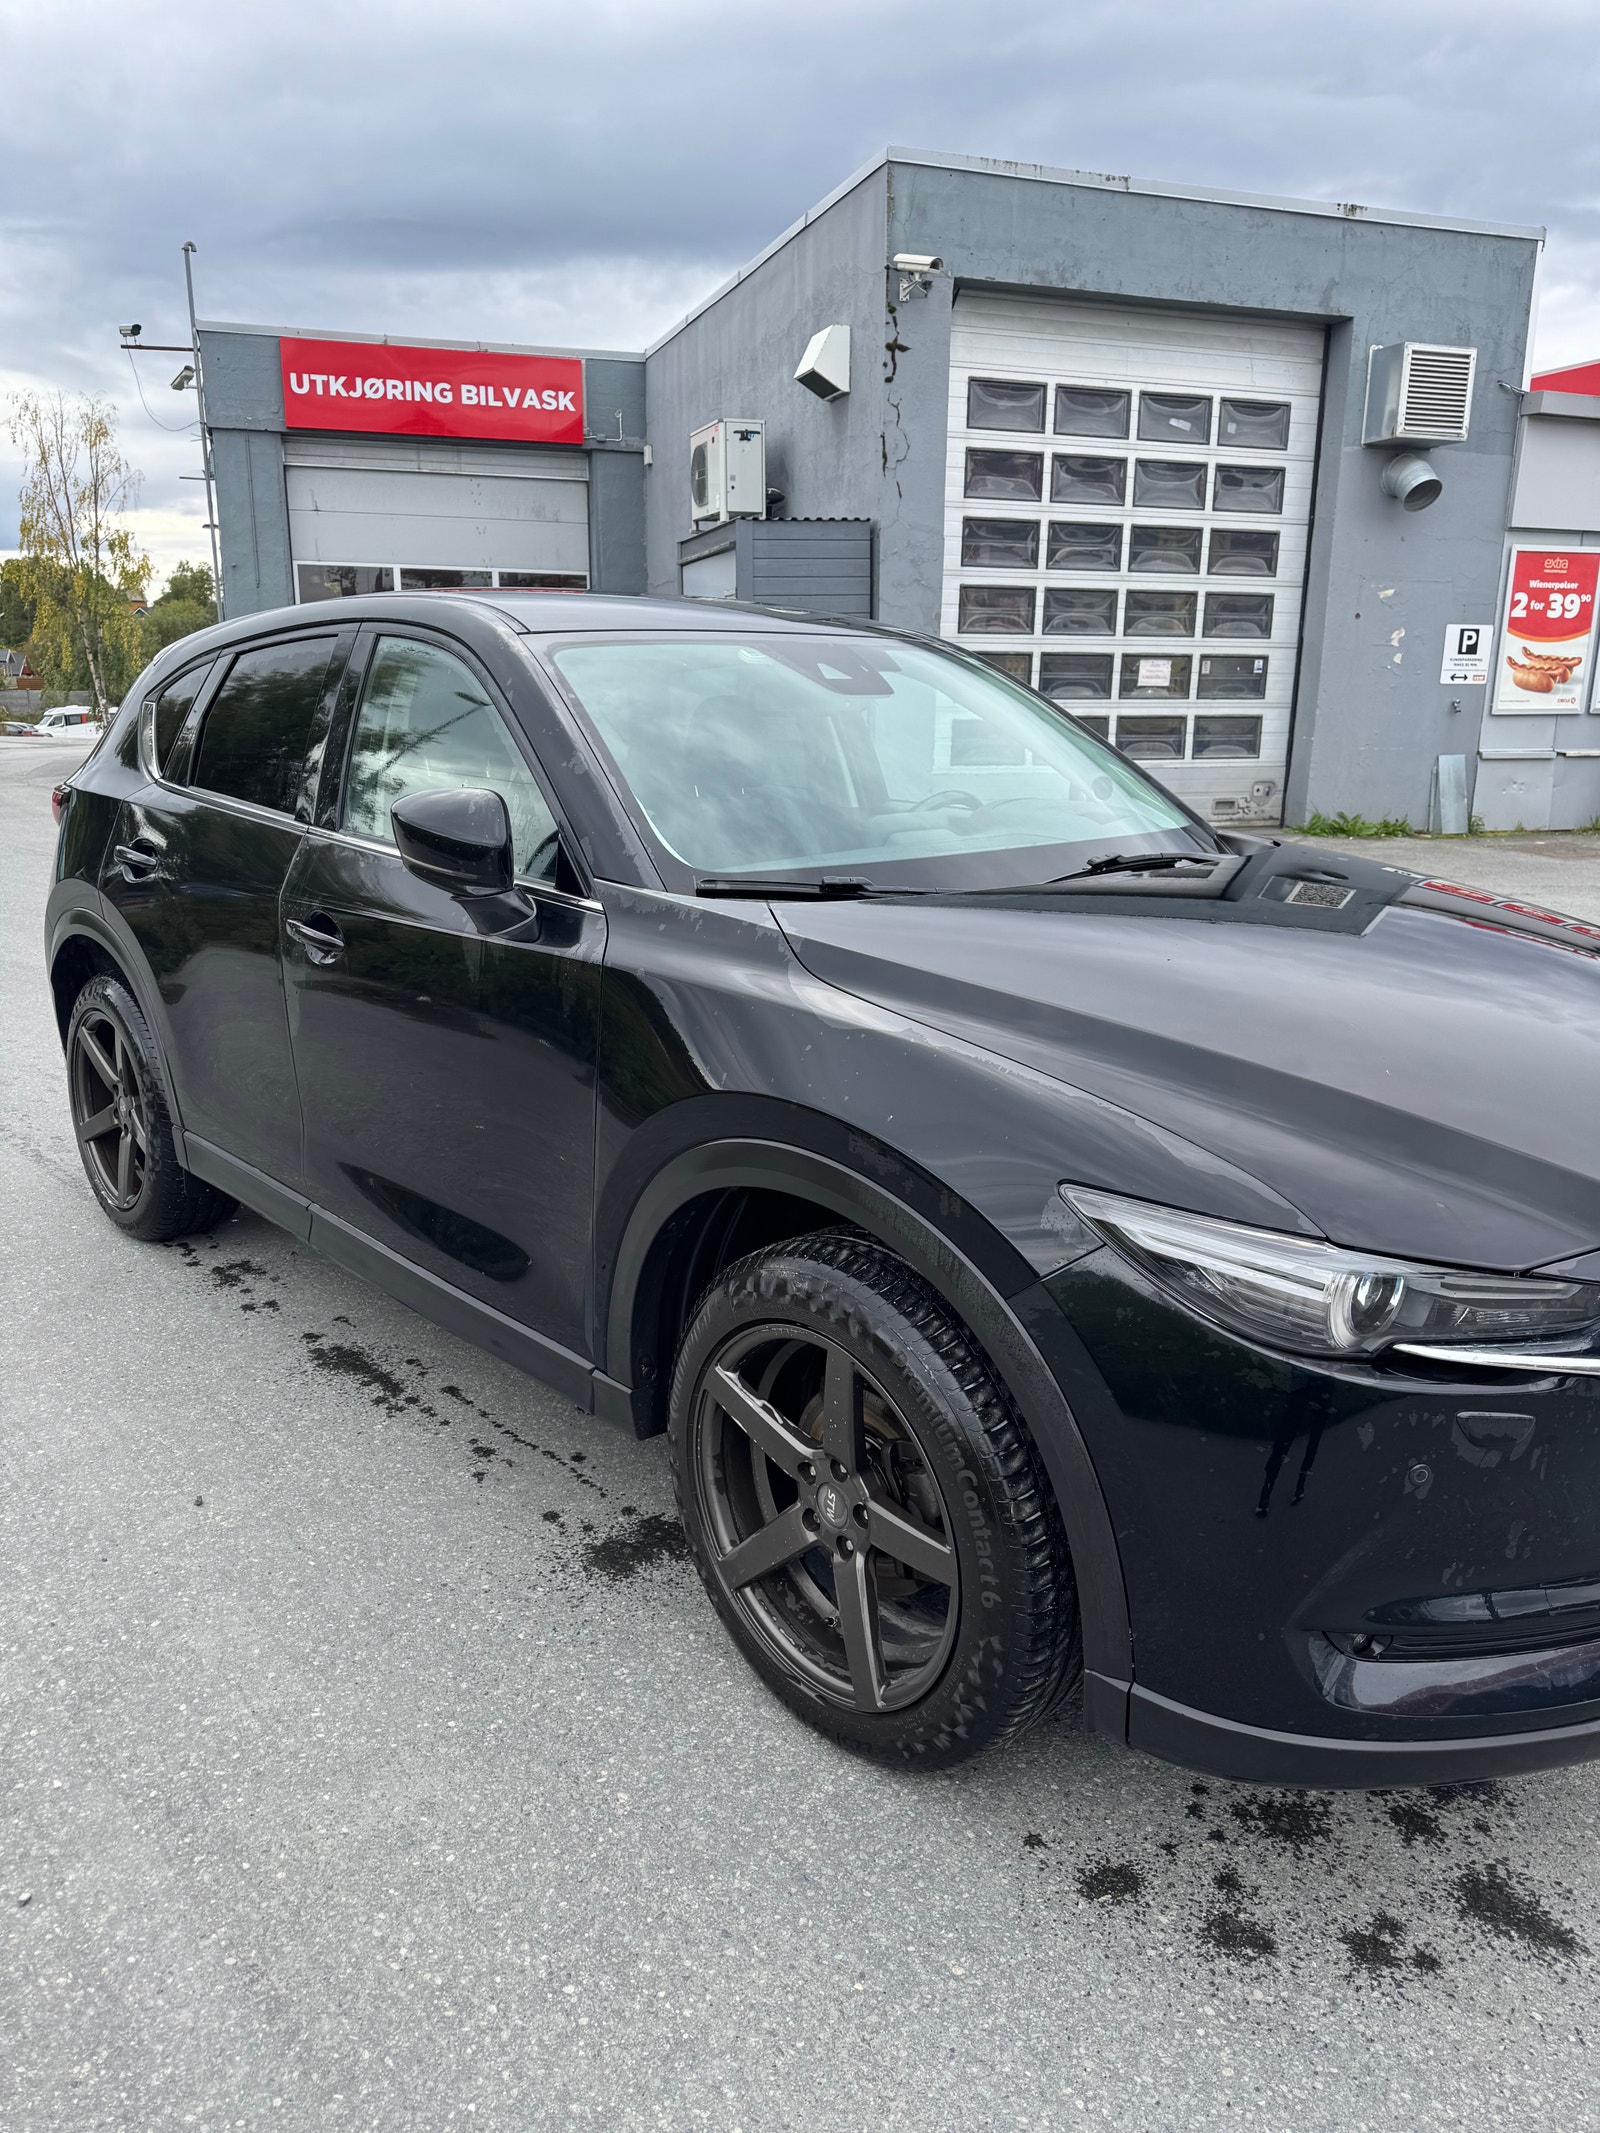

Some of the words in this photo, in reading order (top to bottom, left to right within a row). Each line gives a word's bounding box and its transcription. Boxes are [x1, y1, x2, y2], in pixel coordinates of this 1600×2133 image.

[290, 372, 453, 404] UTKJØRING
[461, 384, 576, 412] BILVASK
[1544, 557, 1569, 569] extra
[1510, 591, 1529, 618] 2
[1530, 600, 1545, 611] for
[1546, 592, 1581, 619] 39
[1461, 630, 1478, 653] P
[980, 1590, 1002, 1609] 6
